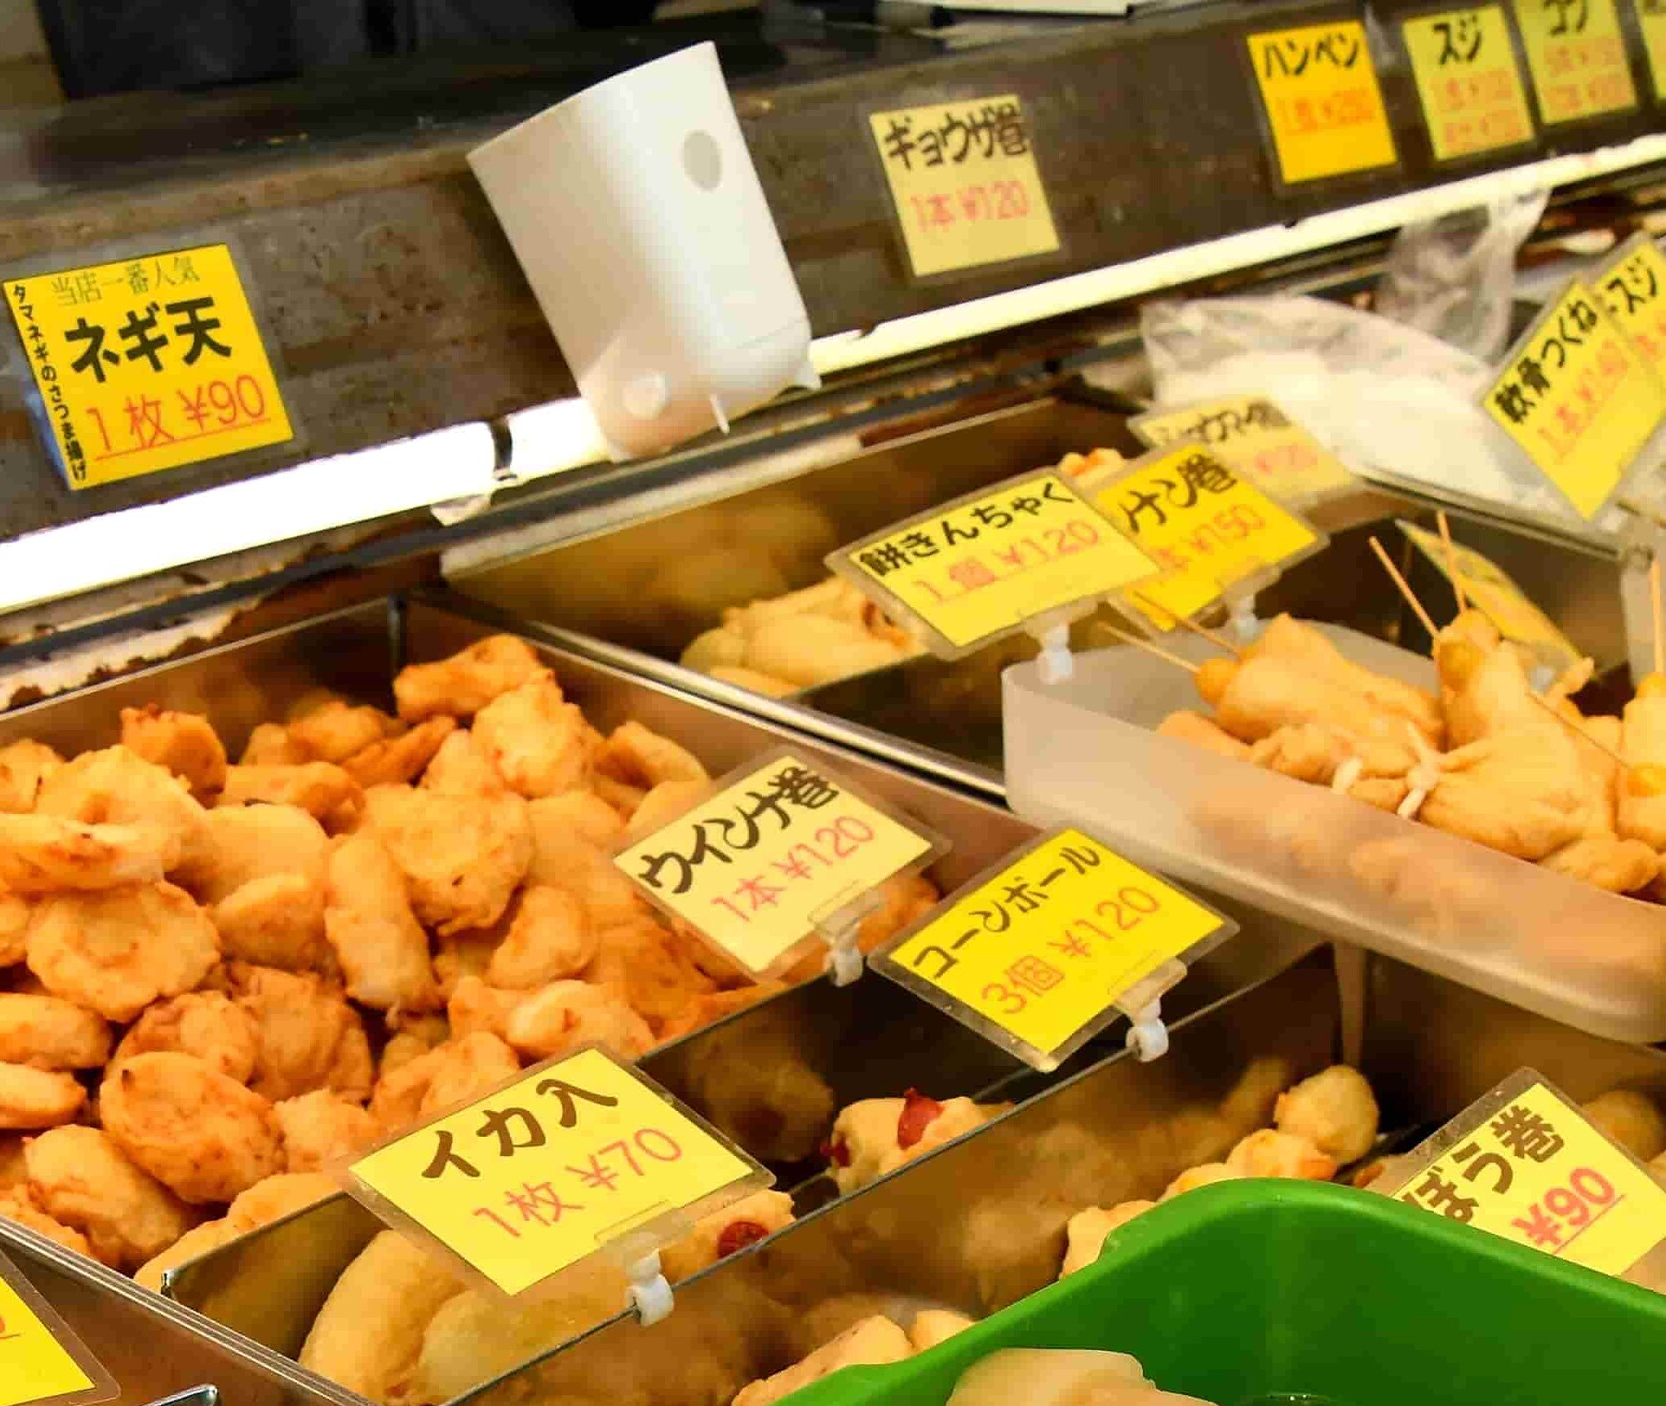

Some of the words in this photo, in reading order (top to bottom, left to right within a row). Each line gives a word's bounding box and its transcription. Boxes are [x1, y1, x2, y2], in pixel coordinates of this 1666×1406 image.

[1263, 32, 1359, 78] ハンペン
[1432, 15, 1482, 65] スジ
[884, 103, 1027, 169] ギョウザ巻
[51, 256, 200, 306] 当店一番人気
[64, 296, 232, 383] ネギ天
[1494, 299, 1598, 424] 軟骨つくね
[177, 374, 265, 431] ¥90
[859, 482, 1075, 577] 餅きんちゃく
[993, 520, 1099, 571] ¥120
[637, 766, 840, 895] ウインナ巻
[779, 815, 876, 881] ¥120
[913, 843, 1103, 978] コーンボール
[1049, 886, 1161, 961] ¥120
[420, 1078, 619, 1179] イカ入
[564, 1128, 682, 1192] ¥70
[1510, 1166, 1616, 1247] ¥90
